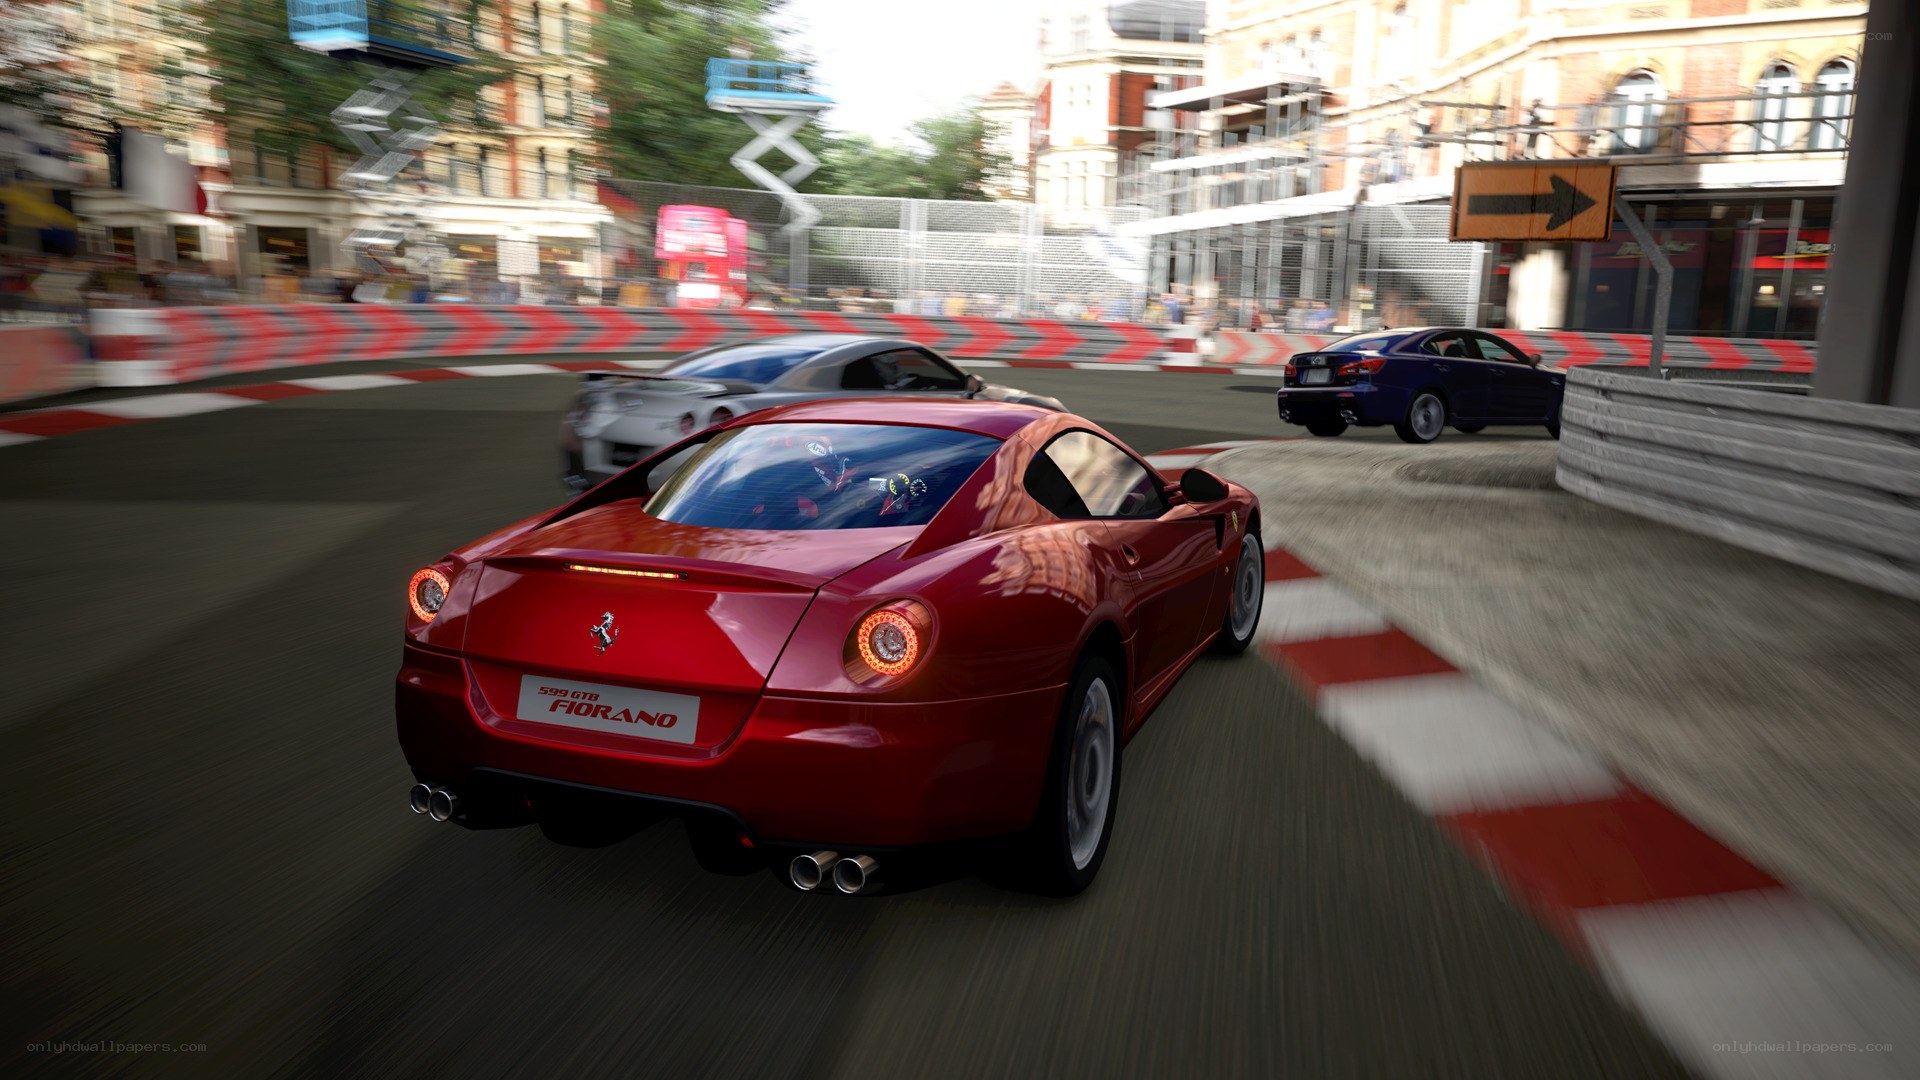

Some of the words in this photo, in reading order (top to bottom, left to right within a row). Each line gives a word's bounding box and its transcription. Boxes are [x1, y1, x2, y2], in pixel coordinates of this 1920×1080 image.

[538, 686, 569, 697] 599
[571, 690, 600, 701] GTB
[549, 699, 678, 729] FIORANO
